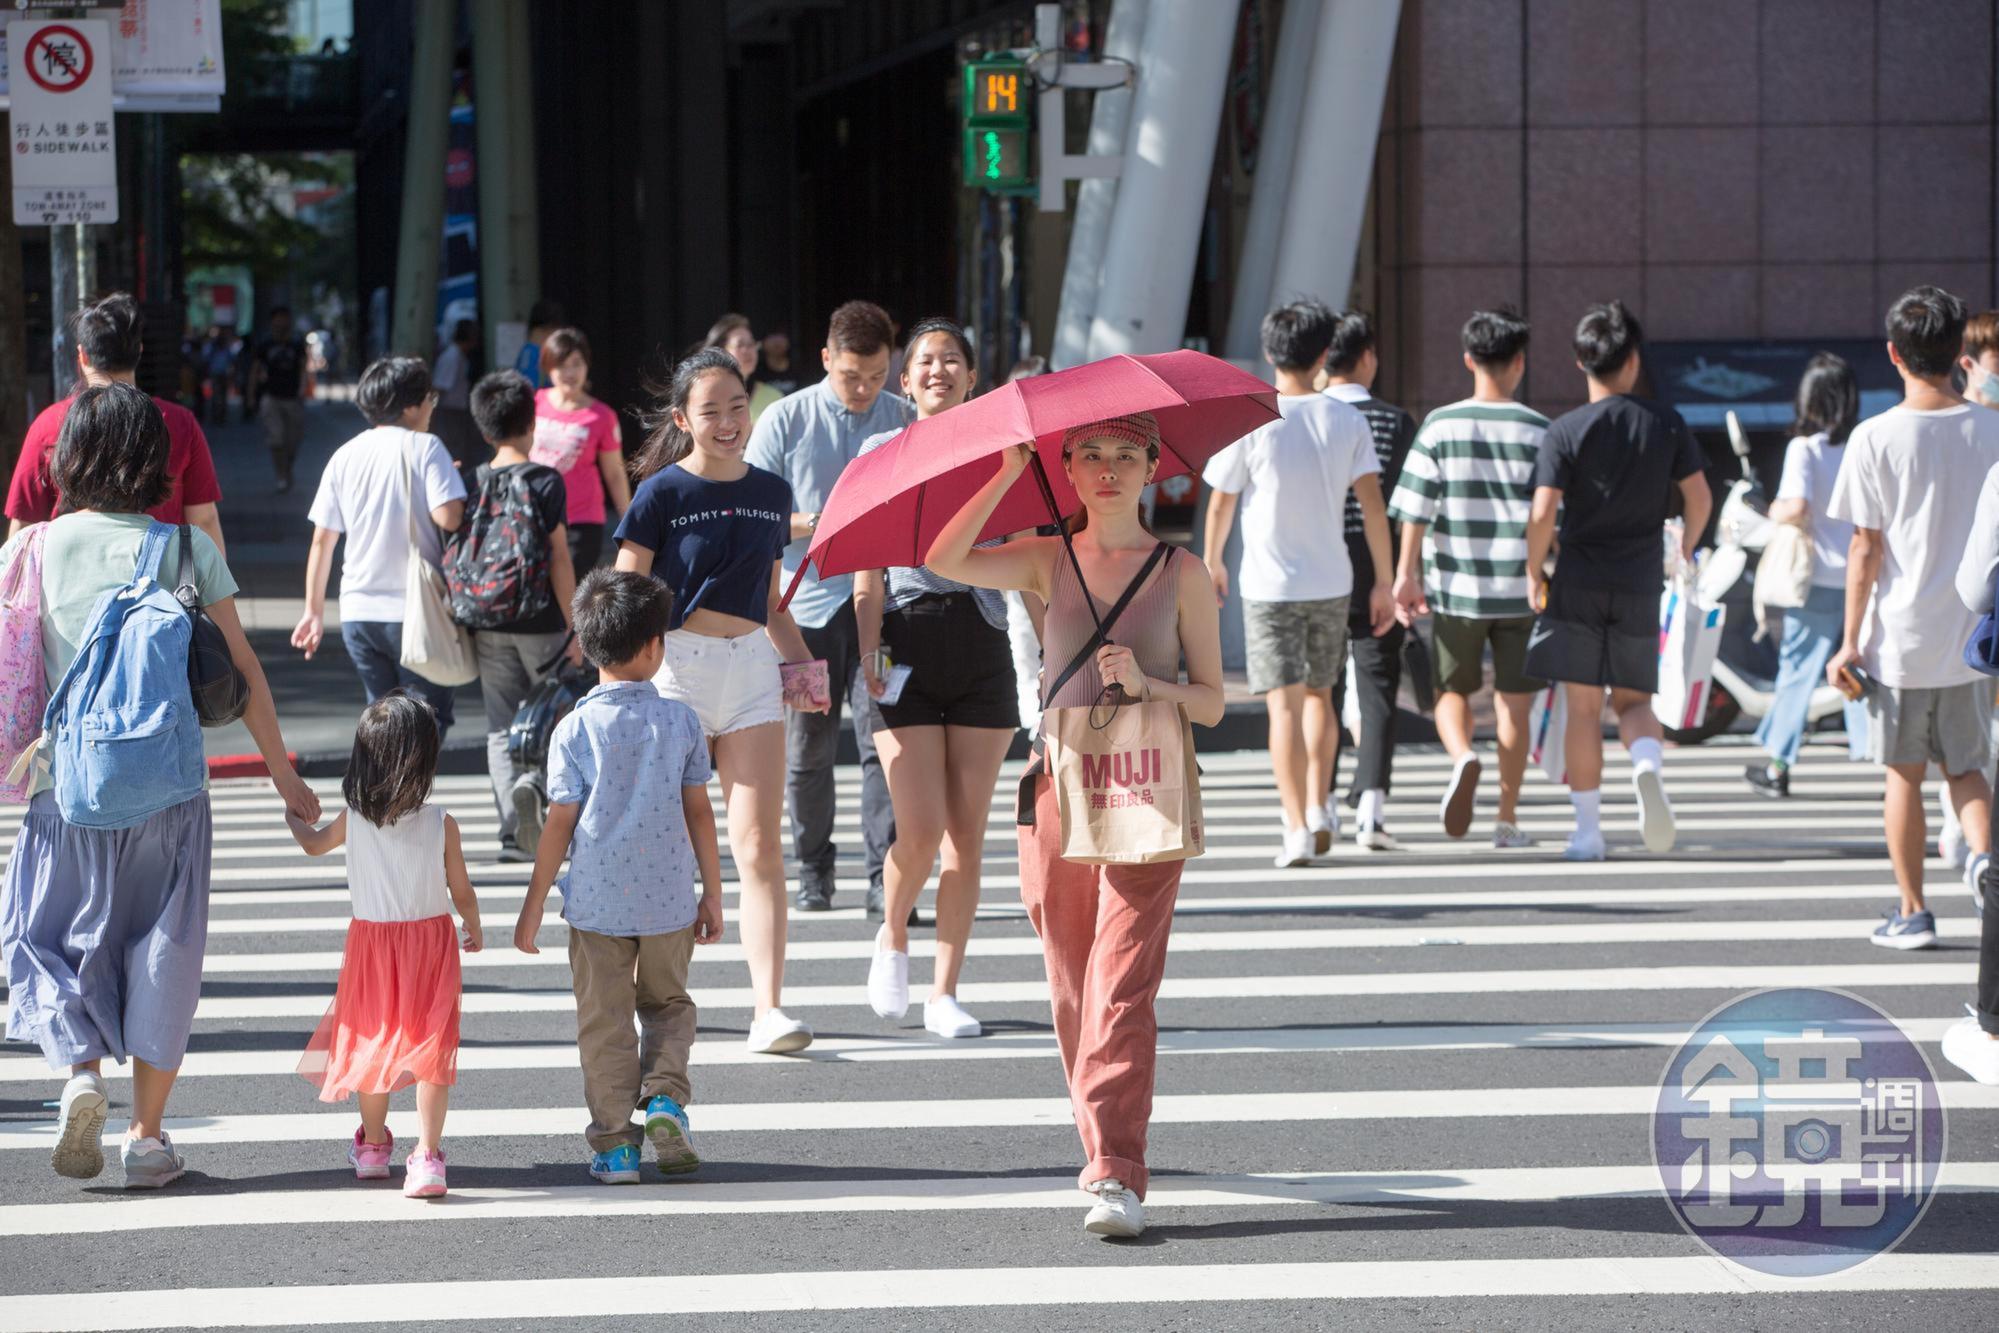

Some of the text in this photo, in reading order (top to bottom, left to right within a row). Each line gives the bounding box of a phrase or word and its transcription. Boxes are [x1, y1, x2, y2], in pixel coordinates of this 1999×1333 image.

[43, 42, 78, 77] 停
[988, 74, 1017, 112] 14
[16, 121, 109, 137] 行人徒步區
[34, 140, 109, 154] SIDEWALK
[670, 507, 781, 528] TOMMY HILFIGER
[1082, 748, 1161, 789] MUJI
[1091, 789, 1154, 809] 無印良品
